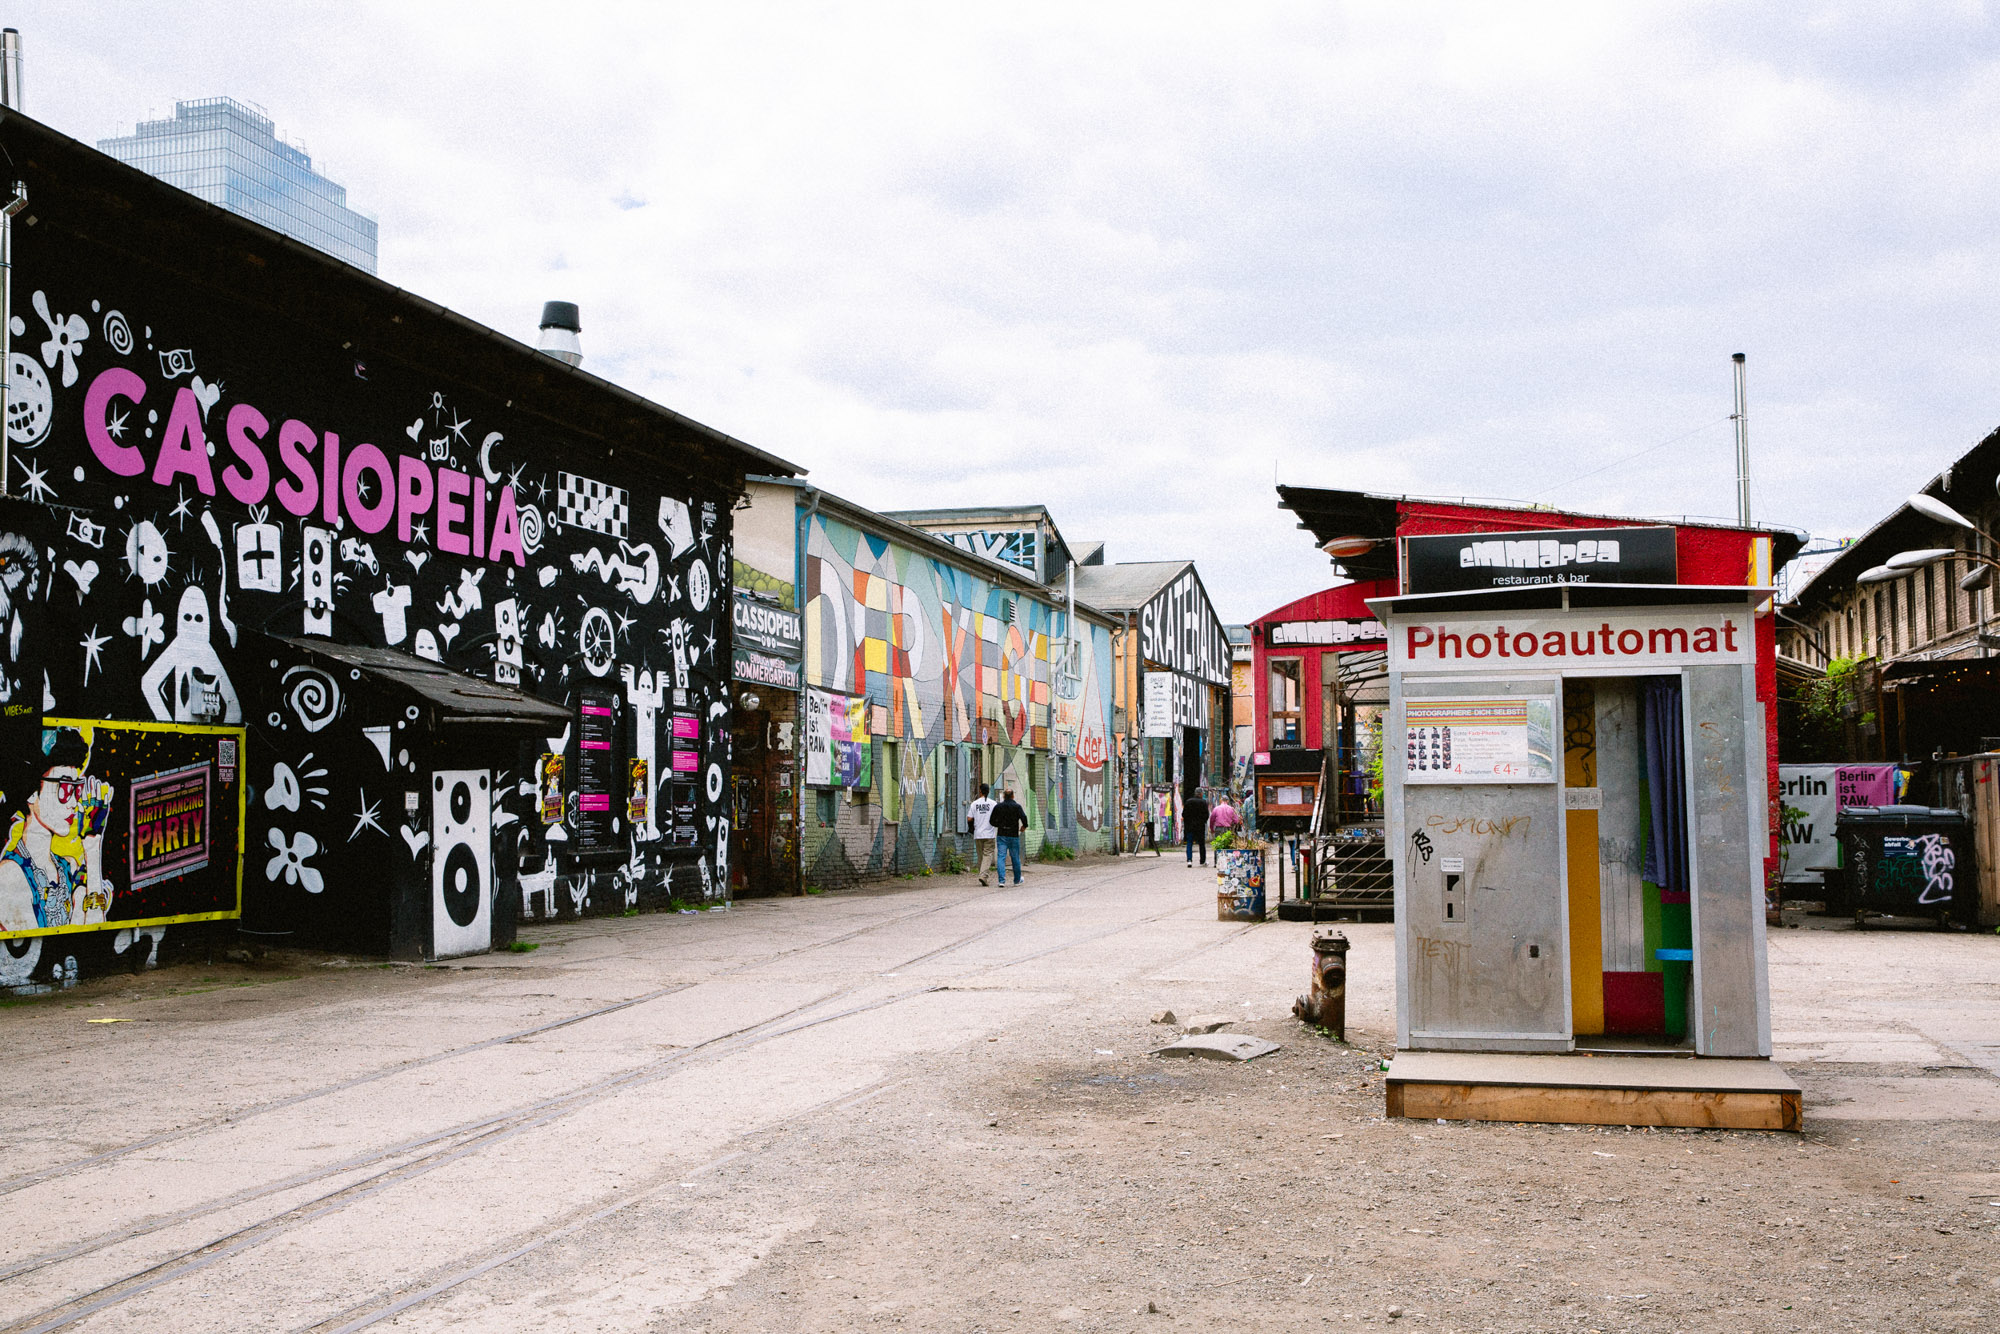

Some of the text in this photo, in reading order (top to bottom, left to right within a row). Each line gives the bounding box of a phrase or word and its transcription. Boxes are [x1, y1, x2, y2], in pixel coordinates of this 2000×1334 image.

[84, 367, 526, 567] CASSIOPEIA
[1493, 573, 1589, 585] restaurant & bar
[733, 602, 801, 641] CASSIOPEIA
[1142, 571, 1230, 687] SKATEHALLE
[1407, 620, 1738, 659] Photoautomat
[1173, 673, 1208, 730] BERLIN
[1407, 709, 1471, 717] PHOTOGRAPHIERE
[1083, 727, 1101, 763] der
[1454, 763, 1462, 774] 4
[1840, 770, 1876, 781] Berlin
[1779, 775, 1827, 795] erlin
[1840, 783, 1857, 794] ist
[137, 803, 164, 824] DIRTY
[166, 793, 204, 817] DANCING
[976, 803, 990, 812] PARIS
[137, 810, 204, 861] PARTY
